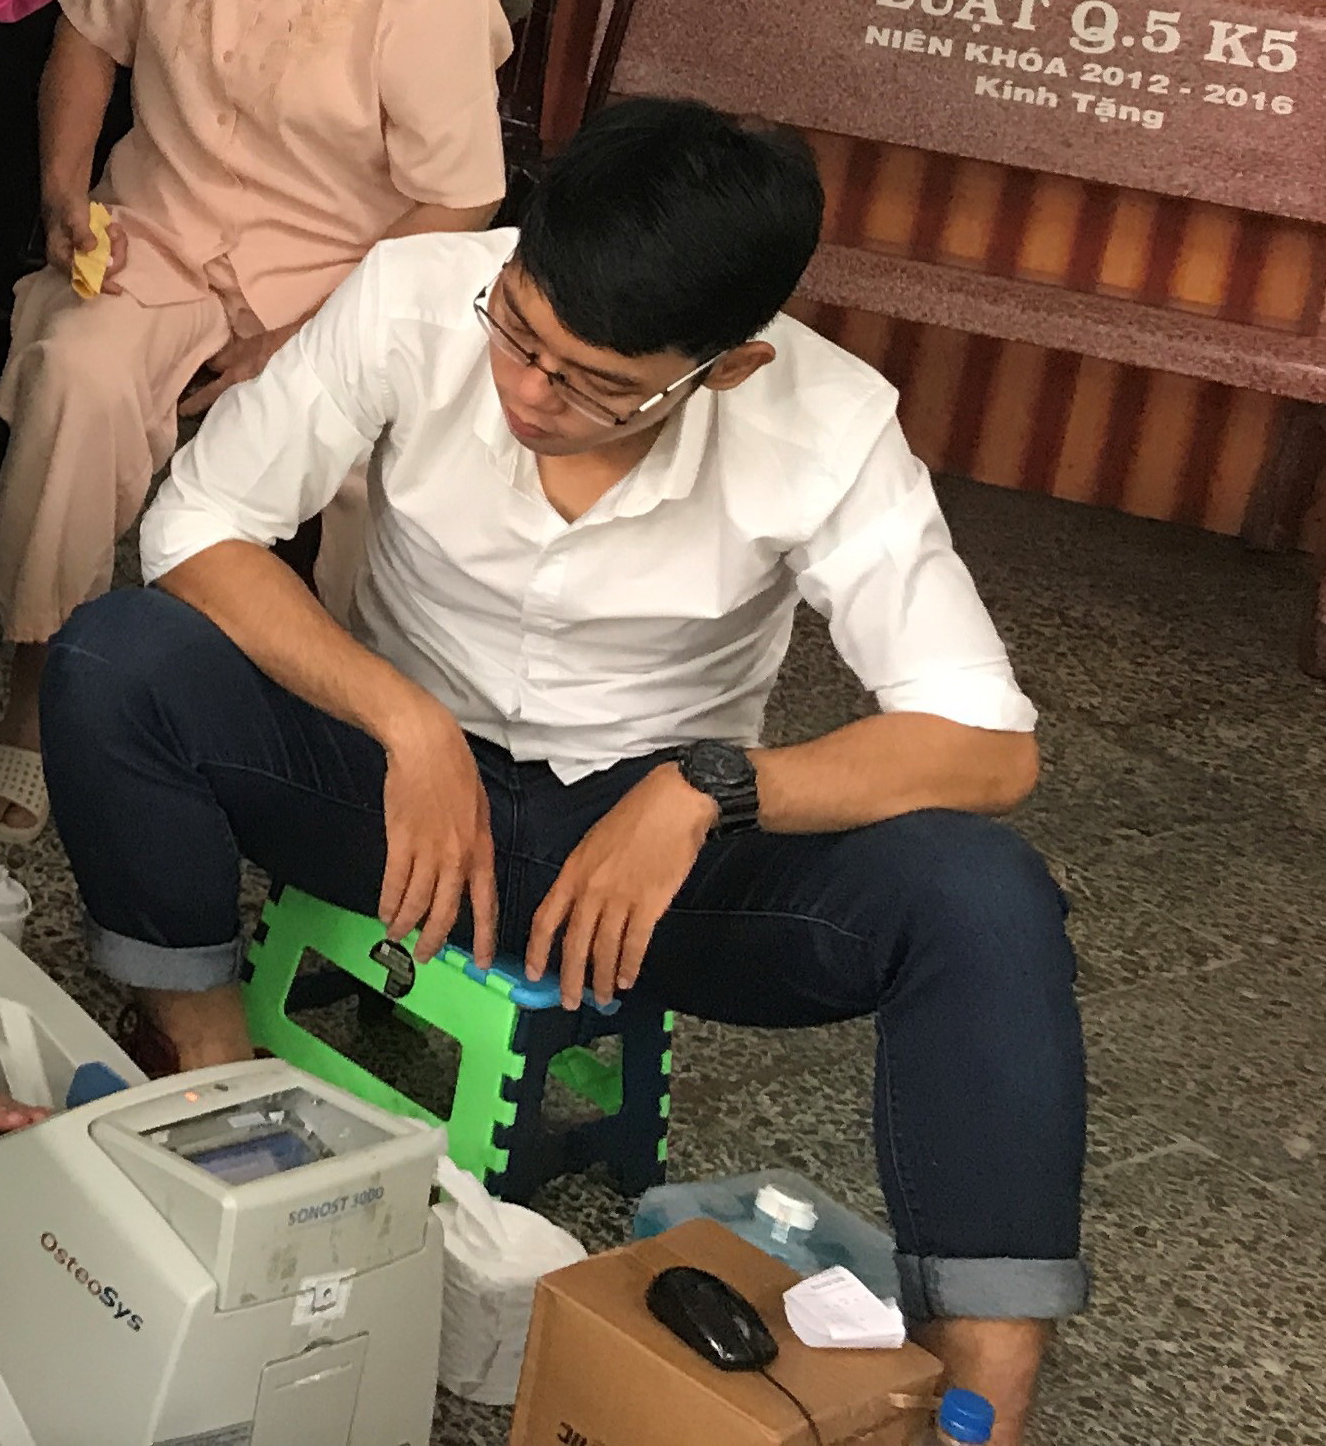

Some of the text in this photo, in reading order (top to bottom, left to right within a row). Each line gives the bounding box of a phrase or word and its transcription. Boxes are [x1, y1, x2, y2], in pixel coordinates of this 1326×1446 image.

[865, 25, 953, 57] NIÊN
[965, 42, 1067, 77] KHÓA
[1080, 63, 1170, 94] 2012
[1203, 84, 1295, 115] 2016
[1069, 0, 1181, 54] Q.5
[1203, 19, 1298, 73] K5
[1072, 91, 1164, 129] Tặng
[288, 1186, 385, 1226] SONOST 3000
[40, 1232, 143, 1332] OsteoSys
